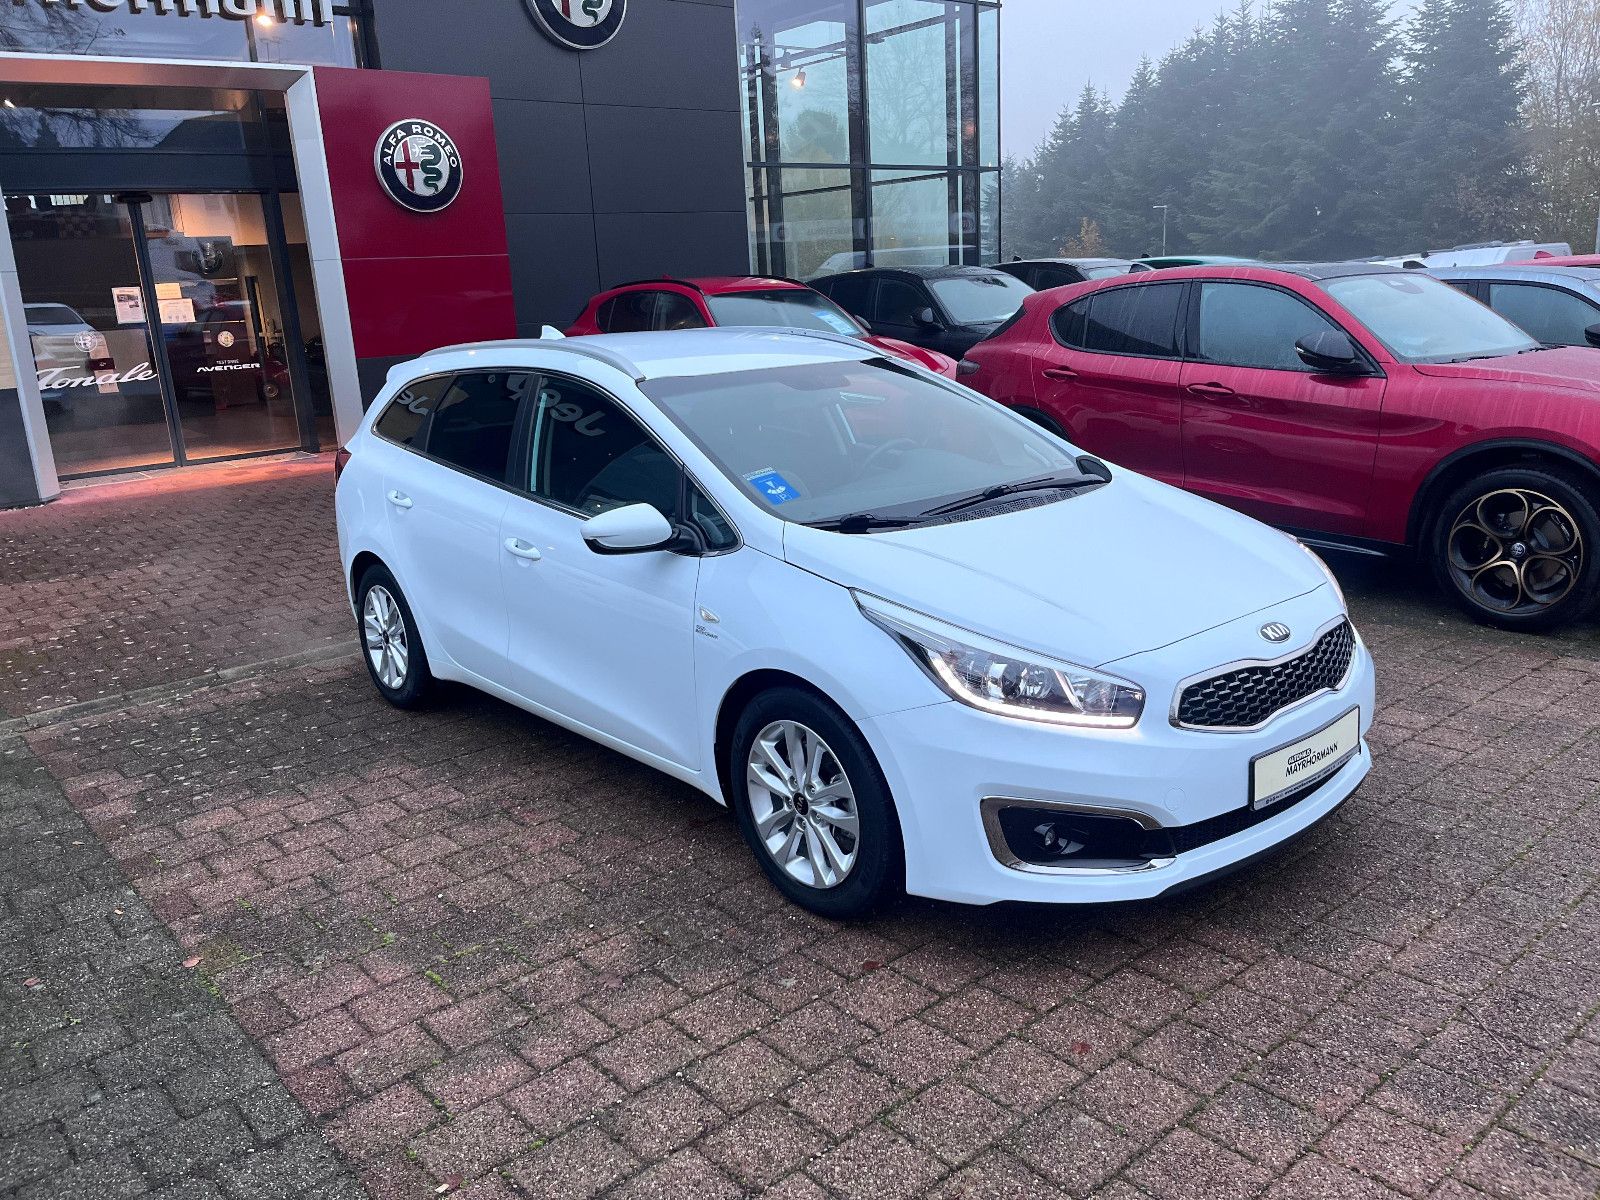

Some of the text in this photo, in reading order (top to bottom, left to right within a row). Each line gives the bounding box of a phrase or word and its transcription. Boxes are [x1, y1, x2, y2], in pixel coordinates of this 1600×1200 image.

[383, 124, 458, 168] ALFA ROMEO
[36, 361, 158, 391] Tonale
[196, 362, 260, 373] AVENGER
[1261, 623, 1290, 640] KIA
[1285, 742, 1338, 777] MAYRHÖRMANN
